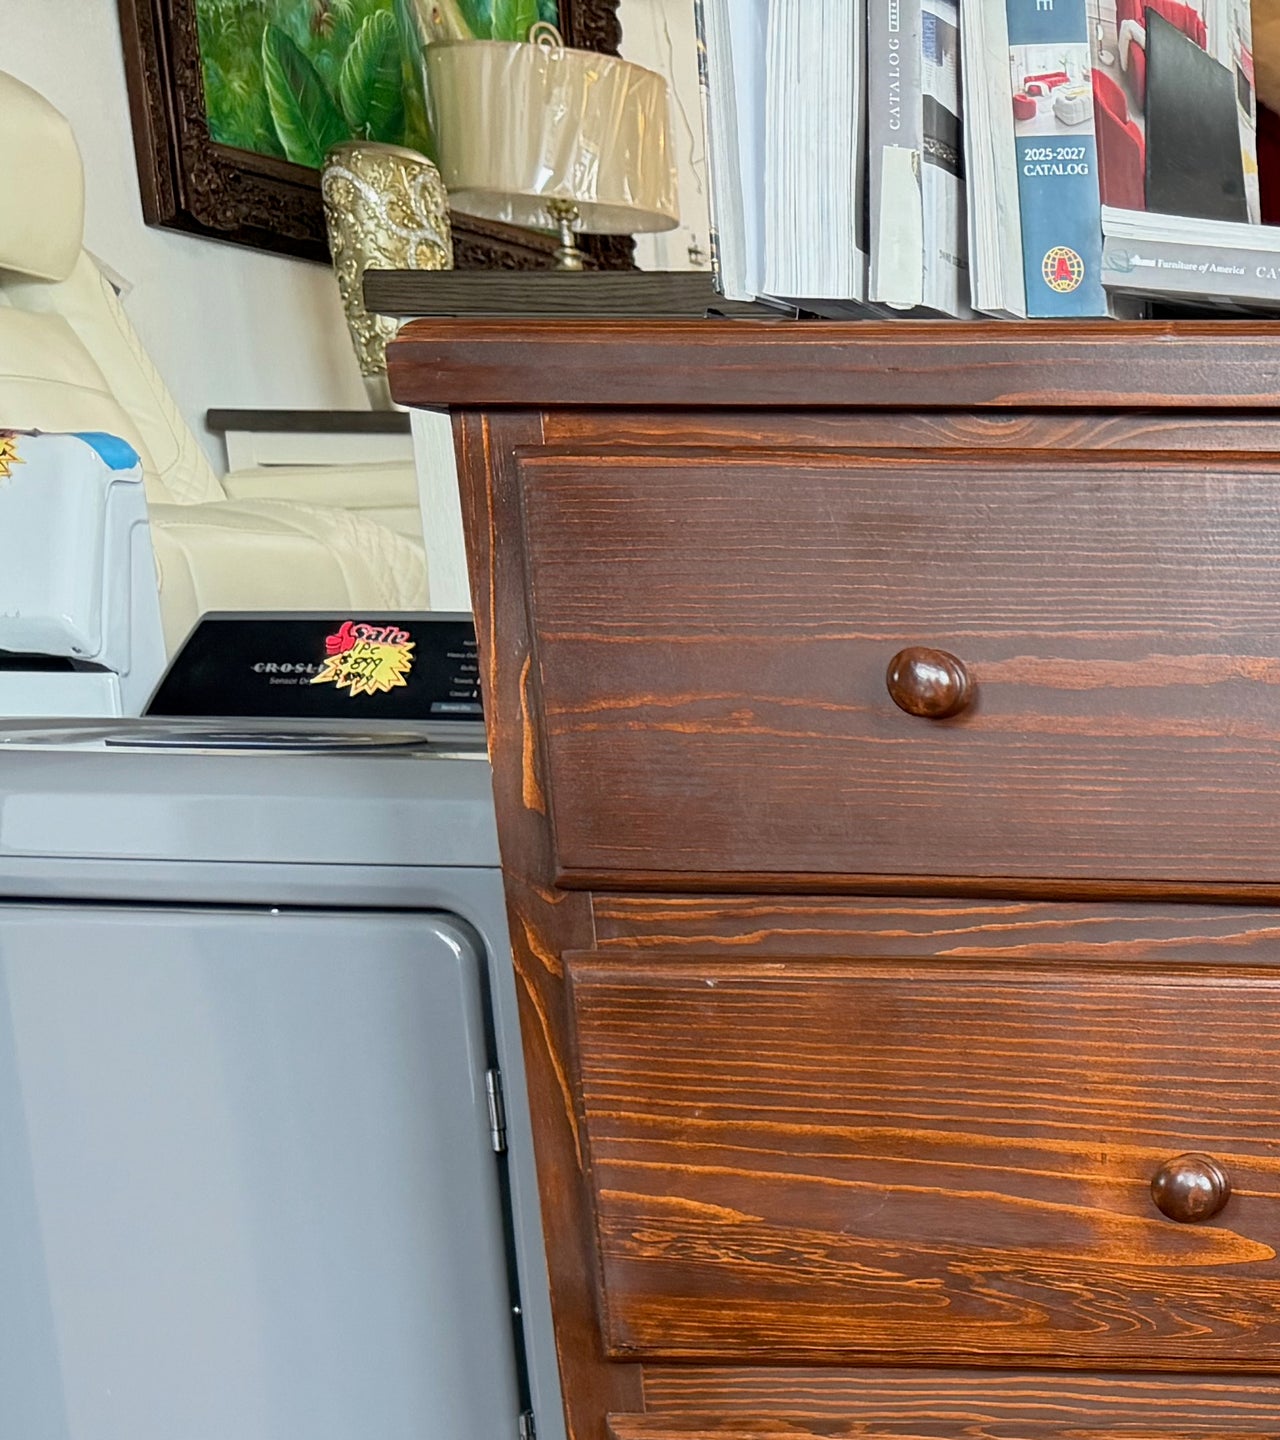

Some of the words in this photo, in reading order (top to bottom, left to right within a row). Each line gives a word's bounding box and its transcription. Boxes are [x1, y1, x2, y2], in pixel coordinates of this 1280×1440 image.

[888, 38, 900, 131] CATALOG
[1024, 147, 1086, 161] 2025-2027
[1023, 163, 1089, 176] CATALOG
[1157, 259, 1198, 271] Furniture
[1198, 263, 1209, 274] of
[1209, 263, 1245, 275] America
[352, 624, 409, 645] Sale
[250, 662, 324, 674] CROSL
